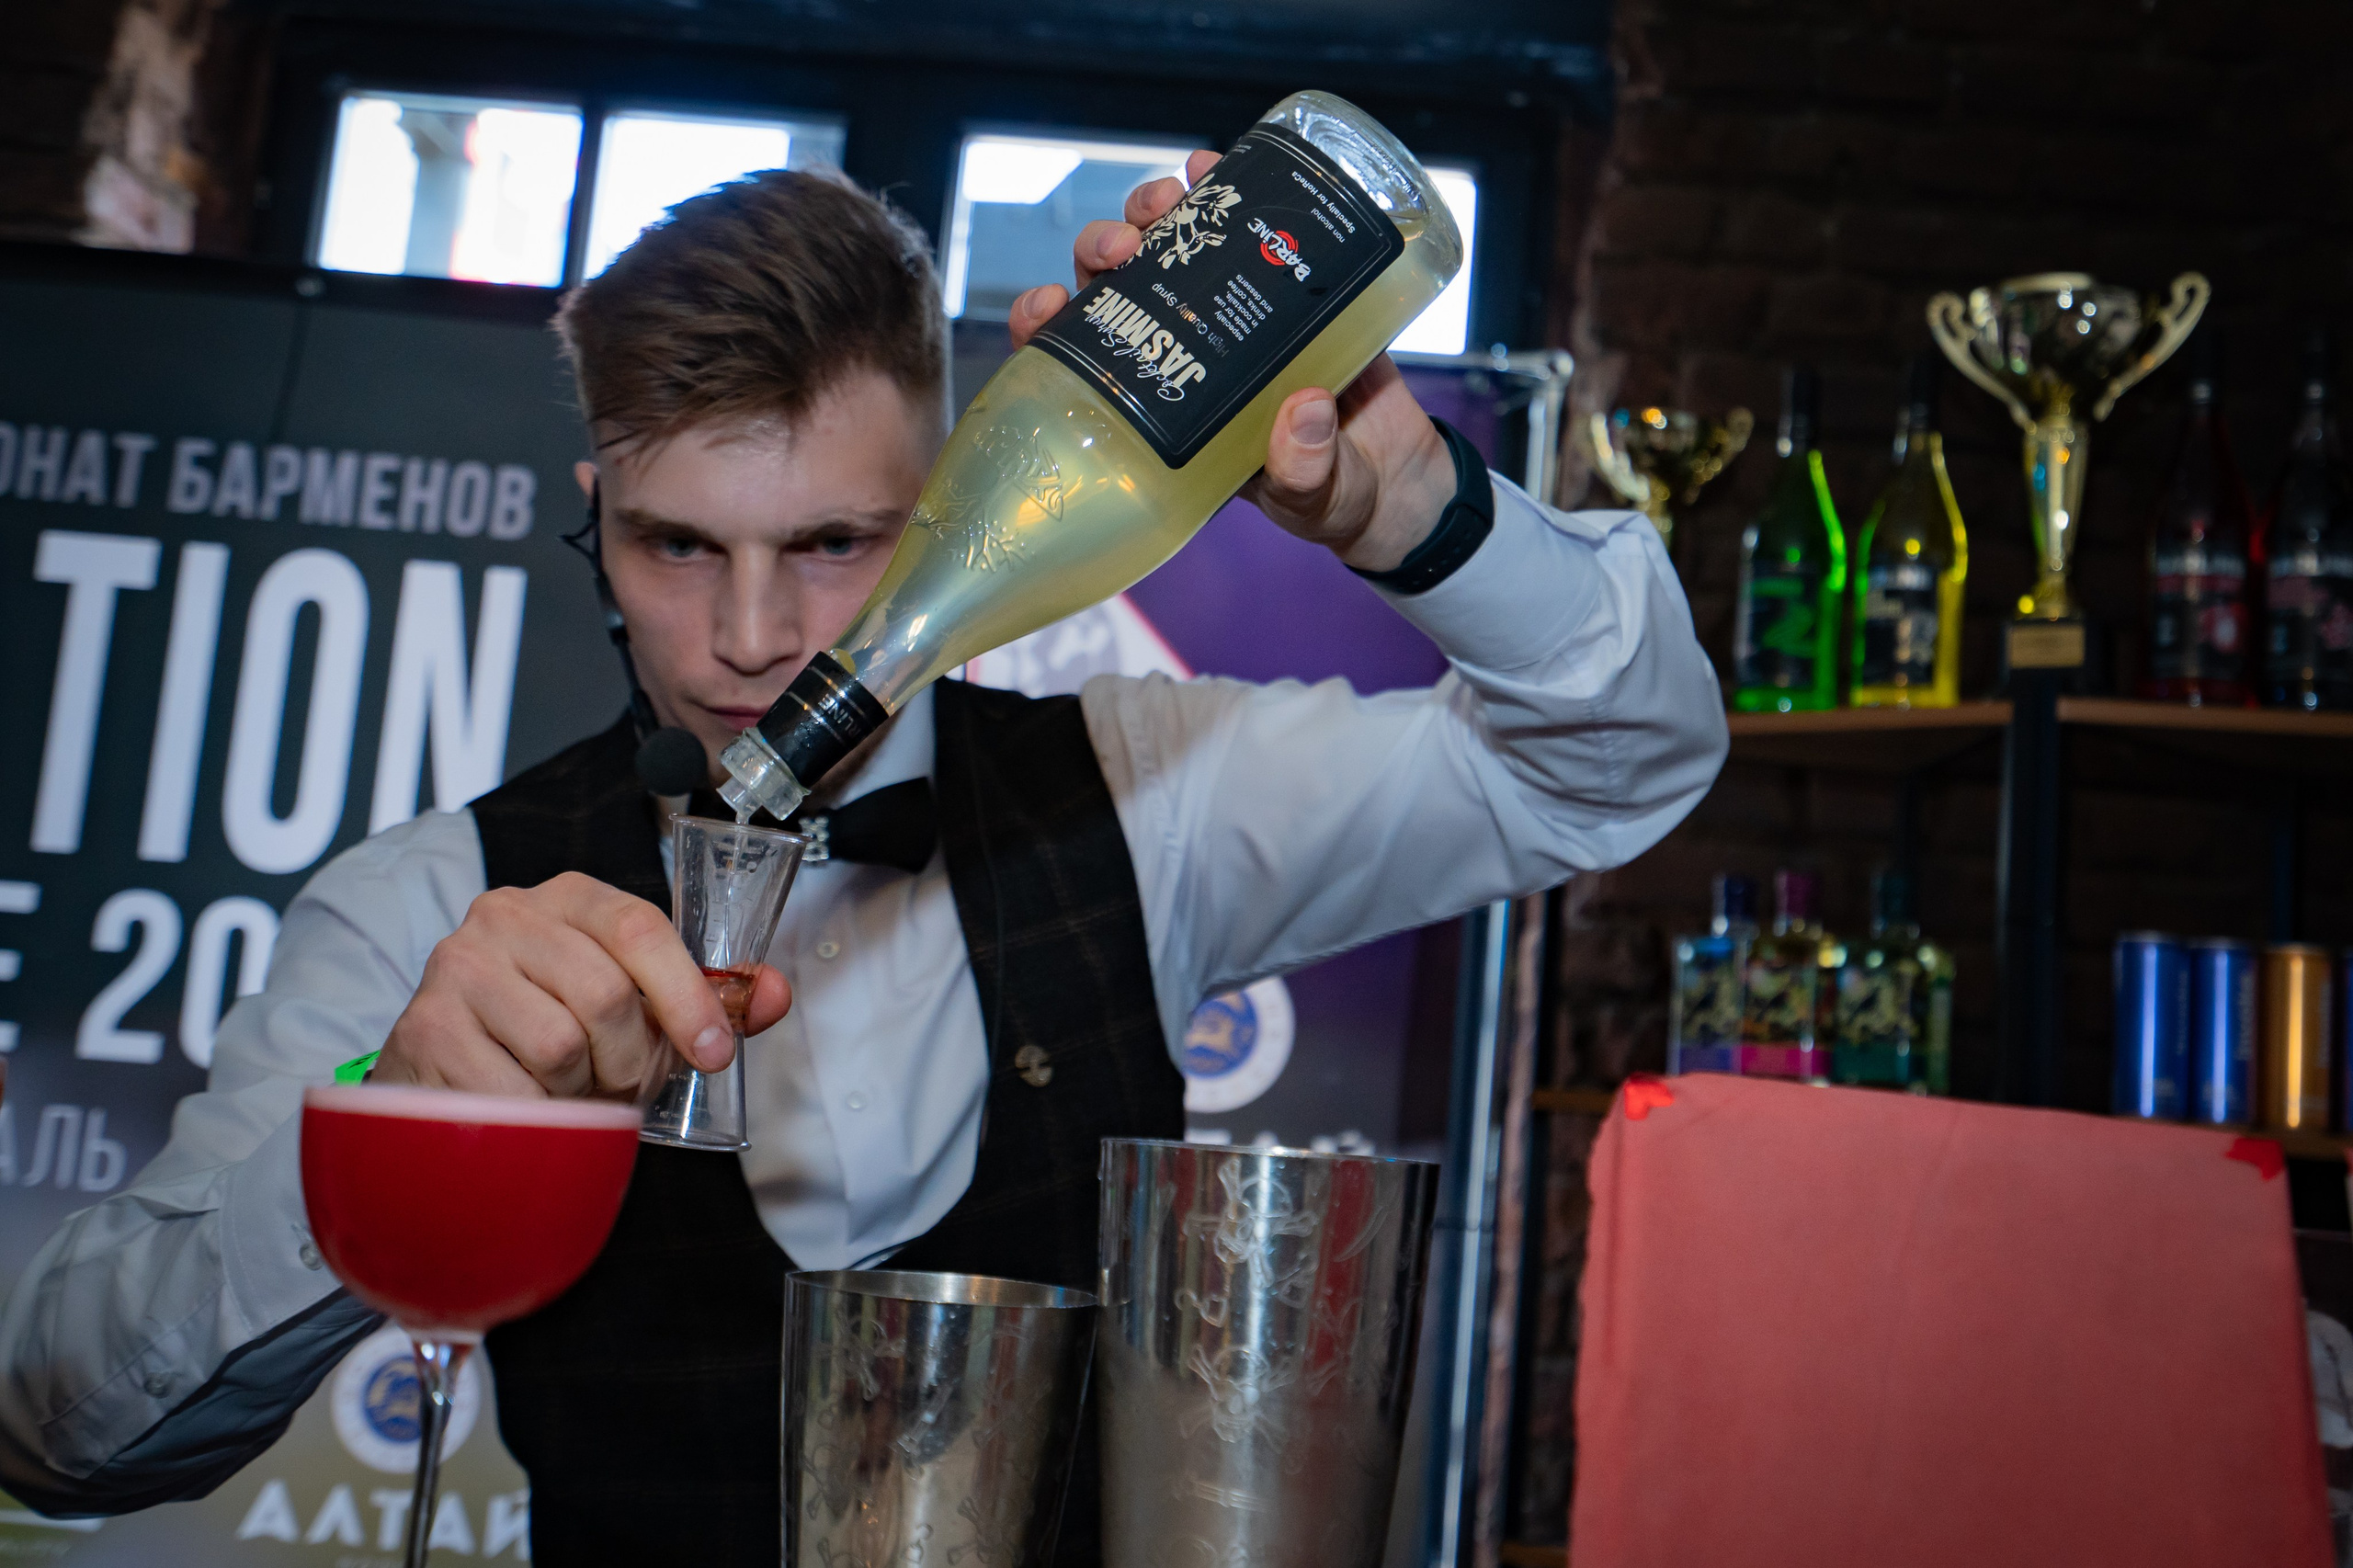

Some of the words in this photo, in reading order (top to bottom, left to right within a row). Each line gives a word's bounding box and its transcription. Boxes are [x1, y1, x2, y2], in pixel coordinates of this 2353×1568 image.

[1291, 171, 1318, 195] HoReCa
[1316, 193, 1328, 204] for
[1311, 208, 1335, 230] alcohol
[1326, 202, 1356, 233] Specially
[1333, 229, 1345, 243] non
[1152, 283, 1177, 306] Syrup
[1227, 280, 1247, 300] coffee
[1235, 274, 1262, 301] desserts
[1213, 295, 1226, 308] use
[1224, 307, 1235, 318] for
[1226, 290, 1253, 320] cocktails,
[1247, 298, 1266, 320] drinks,
[1259, 299, 1273, 312] and
[1085, 310, 1127, 347] Syrup
[1176, 303, 1208, 335] Quality
[1214, 311, 1244, 341] especially
[1233, 315, 1251, 335] made
[1083, 287, 1206, 388] JASMINE
[1207, 331, 1229, 358] High
[1113, 341, 1185, 401] Cocktail
[168, 437, 537, 540] БАРМЕНОВ
[30, 528, 529, 874] TION
